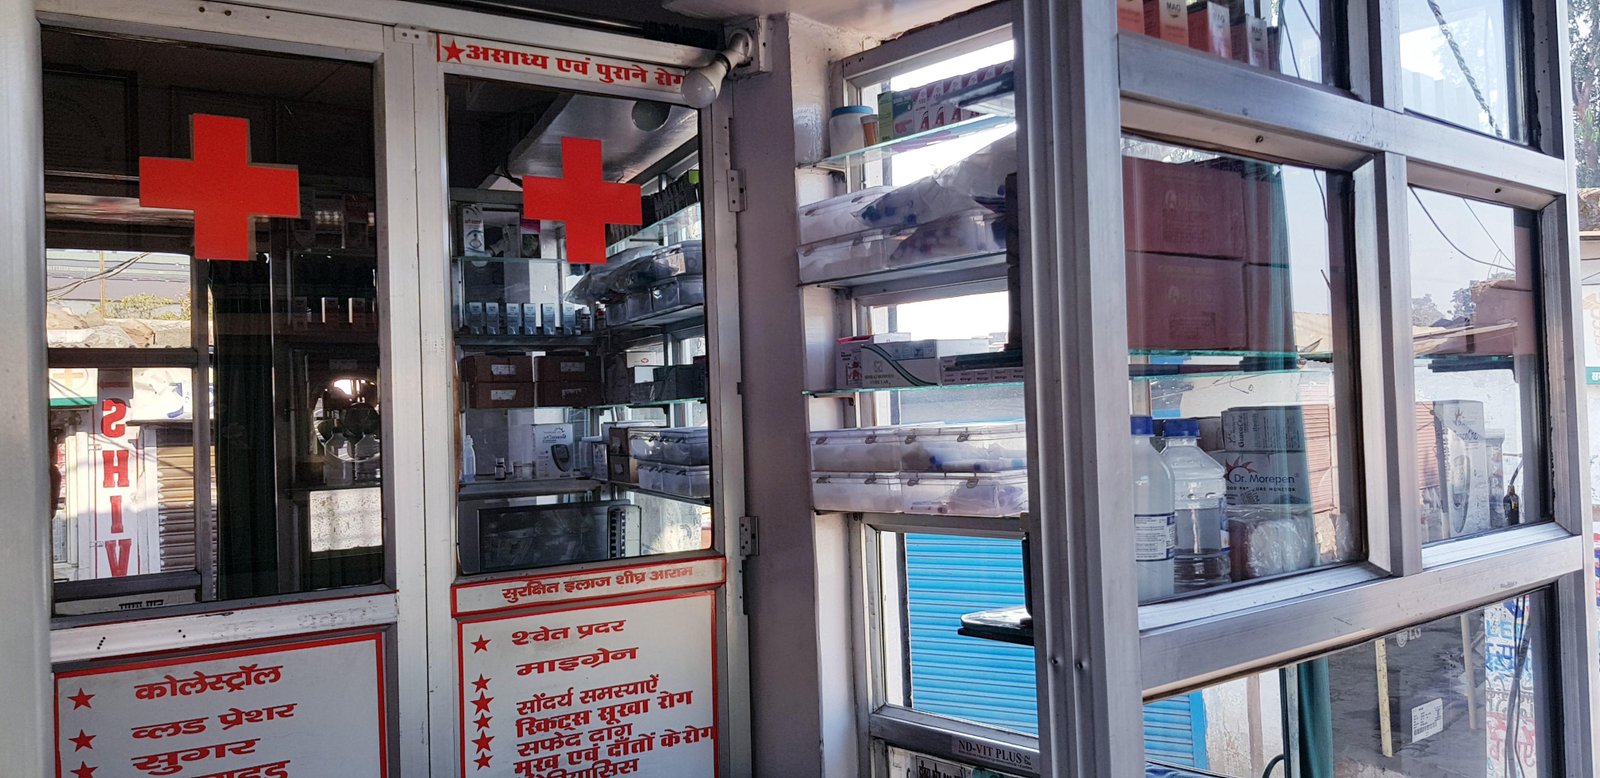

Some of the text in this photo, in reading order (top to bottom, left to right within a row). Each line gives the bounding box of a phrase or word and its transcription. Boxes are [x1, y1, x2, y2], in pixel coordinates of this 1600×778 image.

[465, 43, 549, 69] असाध्य
[555, 57, 592, 75] एवं
[595, 64, 649, 84] पुराने
[1234, 473, 1295, 485] Dr. Morepen
[502, 566, 693, 603] सुरक्षित इलाज शीघ्र आराम
[576, 619, 627, 639] प्रदर
[516, 648, 639, 676] माइग्रेन
[133, 664, 284, 700] कोलेस्ट्रॉल
[217, 703, 298, 731] प्रेशर
[597, 698, 651, 725] सूखा
[657, 690, 693, 710] रोग
[131, 738, 261, 776] सुगर
[516, 731, 584, 757] सफेद
[566, 743, 601, 766] एवं
[958, 740, 993, 757] ND-VIT
[995, 748, 1022, 764] PLUS
